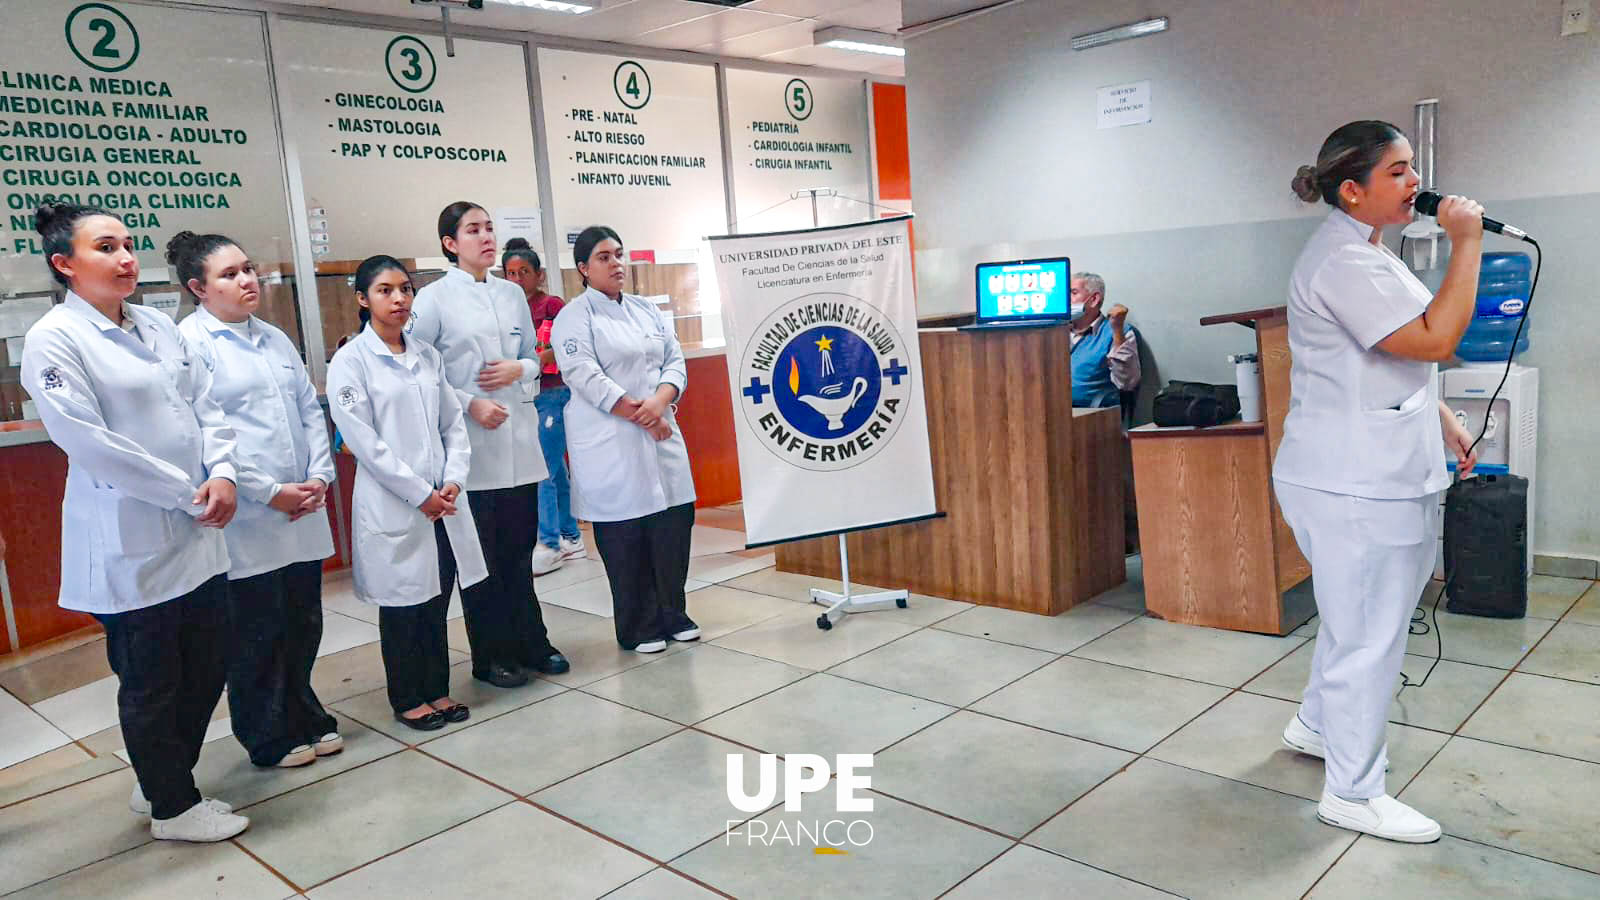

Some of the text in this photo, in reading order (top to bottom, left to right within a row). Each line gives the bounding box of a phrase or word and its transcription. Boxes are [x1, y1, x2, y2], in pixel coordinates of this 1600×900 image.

[89, 19, 120, 58] 2
[400, 48, 422, 81] 3
[0, 71, 173, 97] LINICA MEDICA
[625, 72, 640, 99] 4
[335, 93, 444, 113] GINECOLOGIA
[793, 88, 806, 112] 5
[112, 102, 209, 121] FAMILIAR
[572, 109, 594, 122] PRE
[603, 111, 637, 125] NATAL
[170, 127, 247, 144] ADULTO
[338, 118, 441, 136] MASTOLOGIA
[574, 130, 602, 144] ALTO
[606, 132, 645, 146] RIESGO
[753, 140, 813, 153] CARDIOLOGIA
[815, 142, 852, 154] INFANTIL
[0, 145, 201, 165] CIRUGIA GENERAL
[341, 143, 371, 158] PAP
[376, 144, 387, 158] Y
[393, 145, 507, 162] COLPOSCOPIA
[576, 152, 658, 167] PLANIFICACION
[661, 155, 706, 168] FAMILIAR
[755, 158, 793, 170] CIRUGIA
[795, 159, 832, 171] INFANTIL
[3, 169, 242, 187] CIRUGIA ONCOLOGICA
[578, 173, 625, 186] INFANTO
[628, 174, 671, 187] JUVENIL
[148, 194, 230, 209] CLINICA
[719, 235, 904, 264] UNIVERSIDAD PRIVADA DEL ESTE
[742, 253, 885, 276] Facultad De Ciencias de la Salud
[757, 276, 810, 289] Licenciatura
[752, 302, 896, 371] FACULTAD DE CIENCIAS DE LA SALUD
[759, 399, 900, 462] ENFERMERÍA
